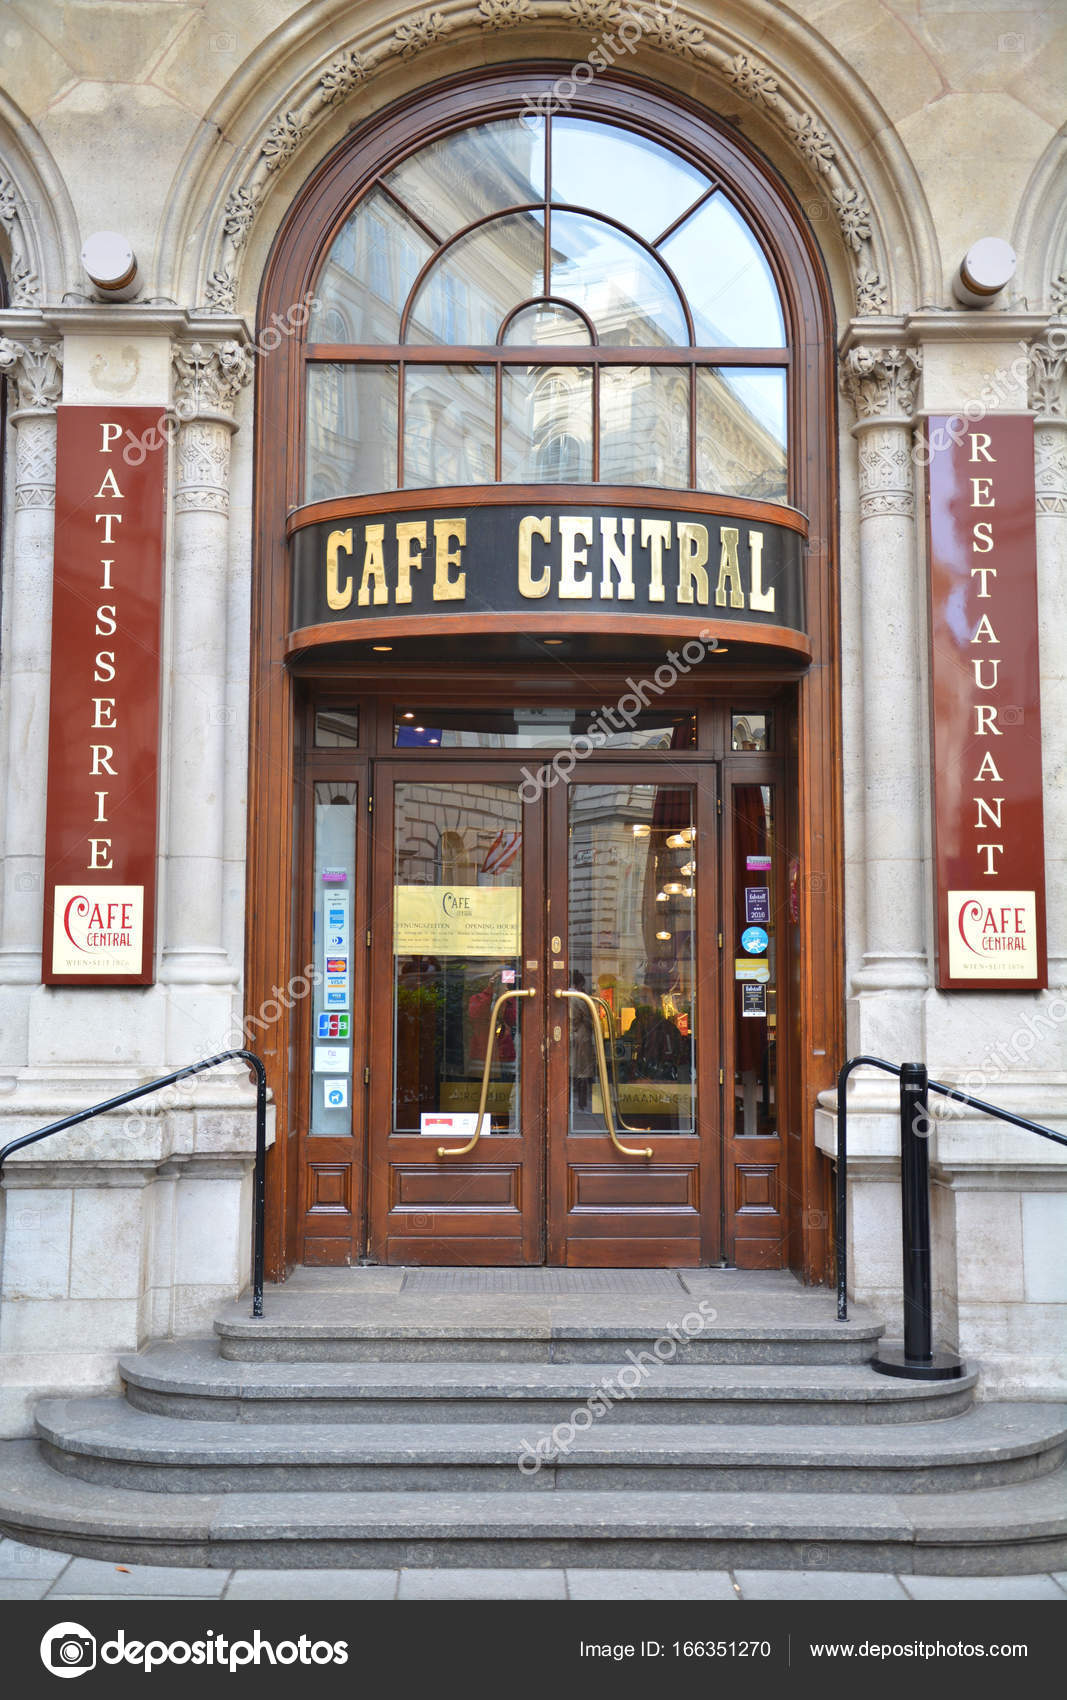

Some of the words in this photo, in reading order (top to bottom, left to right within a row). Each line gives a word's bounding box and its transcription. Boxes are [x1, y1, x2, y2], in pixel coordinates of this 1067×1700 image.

[326, 517, 467, 611] CAFE
[517, 515, 776, 613] CENTRAL
[87, 423, 125, 869] PATISSERIE
[968, 432, 1006, 876] RESTAURANT
[63, 895, 133, 955] CAFE
[442, 891, 471, 918] CAFE
[958, 899, 1026, 958] CAFE
[87, 932, 133, 947] CENTRAL
[982, 936, 1028, 951] CENTRAL
